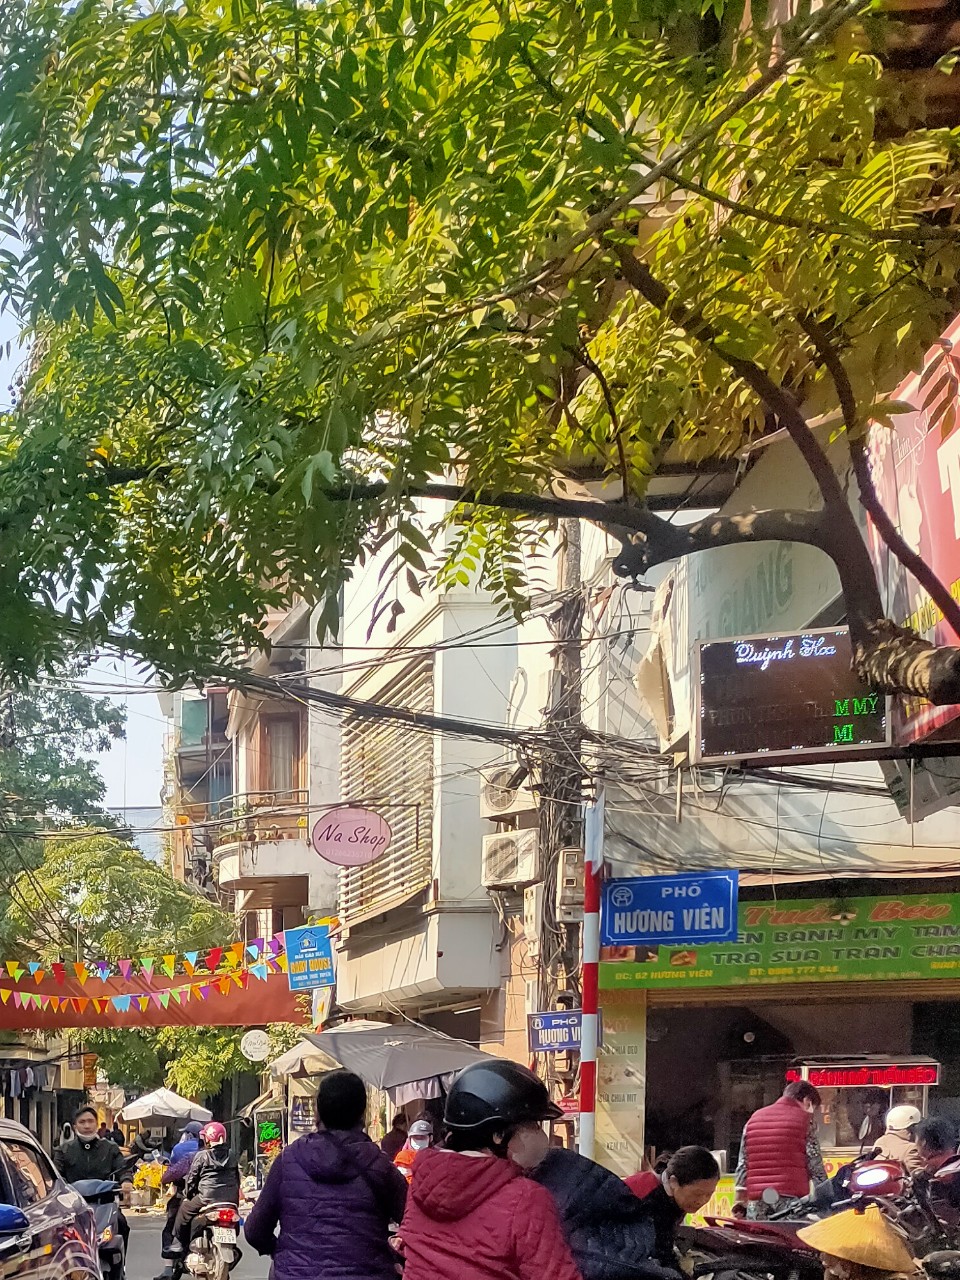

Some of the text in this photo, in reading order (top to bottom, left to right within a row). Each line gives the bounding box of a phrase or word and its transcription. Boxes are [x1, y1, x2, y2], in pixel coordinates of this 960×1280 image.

[318, 824, 386, 852] Na Shop
[661, 880, 702, 898] PHỐ
[614, 902, 724, 934] HƯƠNG VIÊN
[571, 1026, 582, 1041] VI
